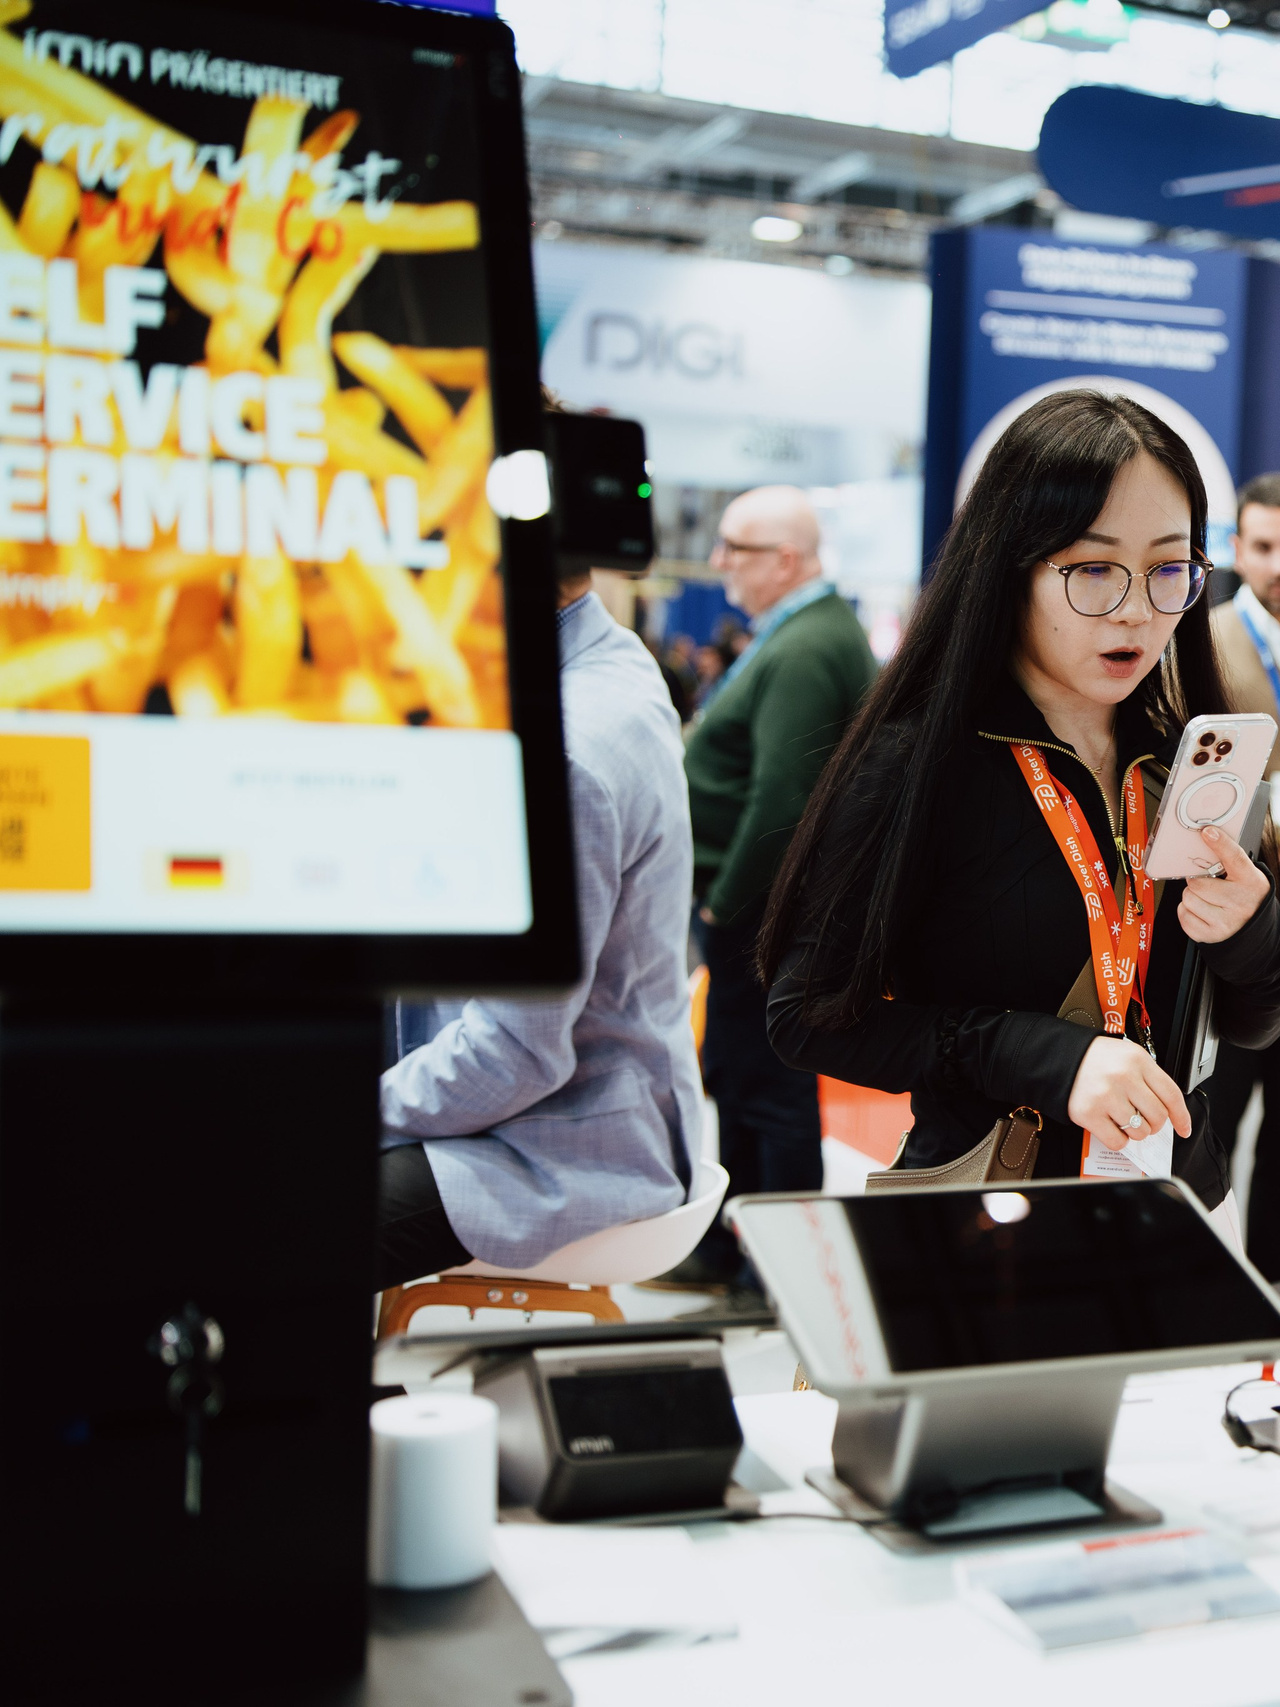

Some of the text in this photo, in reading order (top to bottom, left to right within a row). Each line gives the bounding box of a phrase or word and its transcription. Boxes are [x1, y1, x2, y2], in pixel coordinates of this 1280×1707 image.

[150, 48, 344, 112] PRÄSENTIERT
[583, 310, 748, 382] DIGI
[0, 346, 329, 467] ERVICE
[0, 441, 452, 571] ERMINAL
[1027, 757, 1044, 781] Ever
[1127, 791, 1138, 814] Dish
[1065, 836, 1093, 888] Ever Dish
[1098, 871, 1110, 889] GK
[1100, 951, 1118, 1007] Ever Dish
